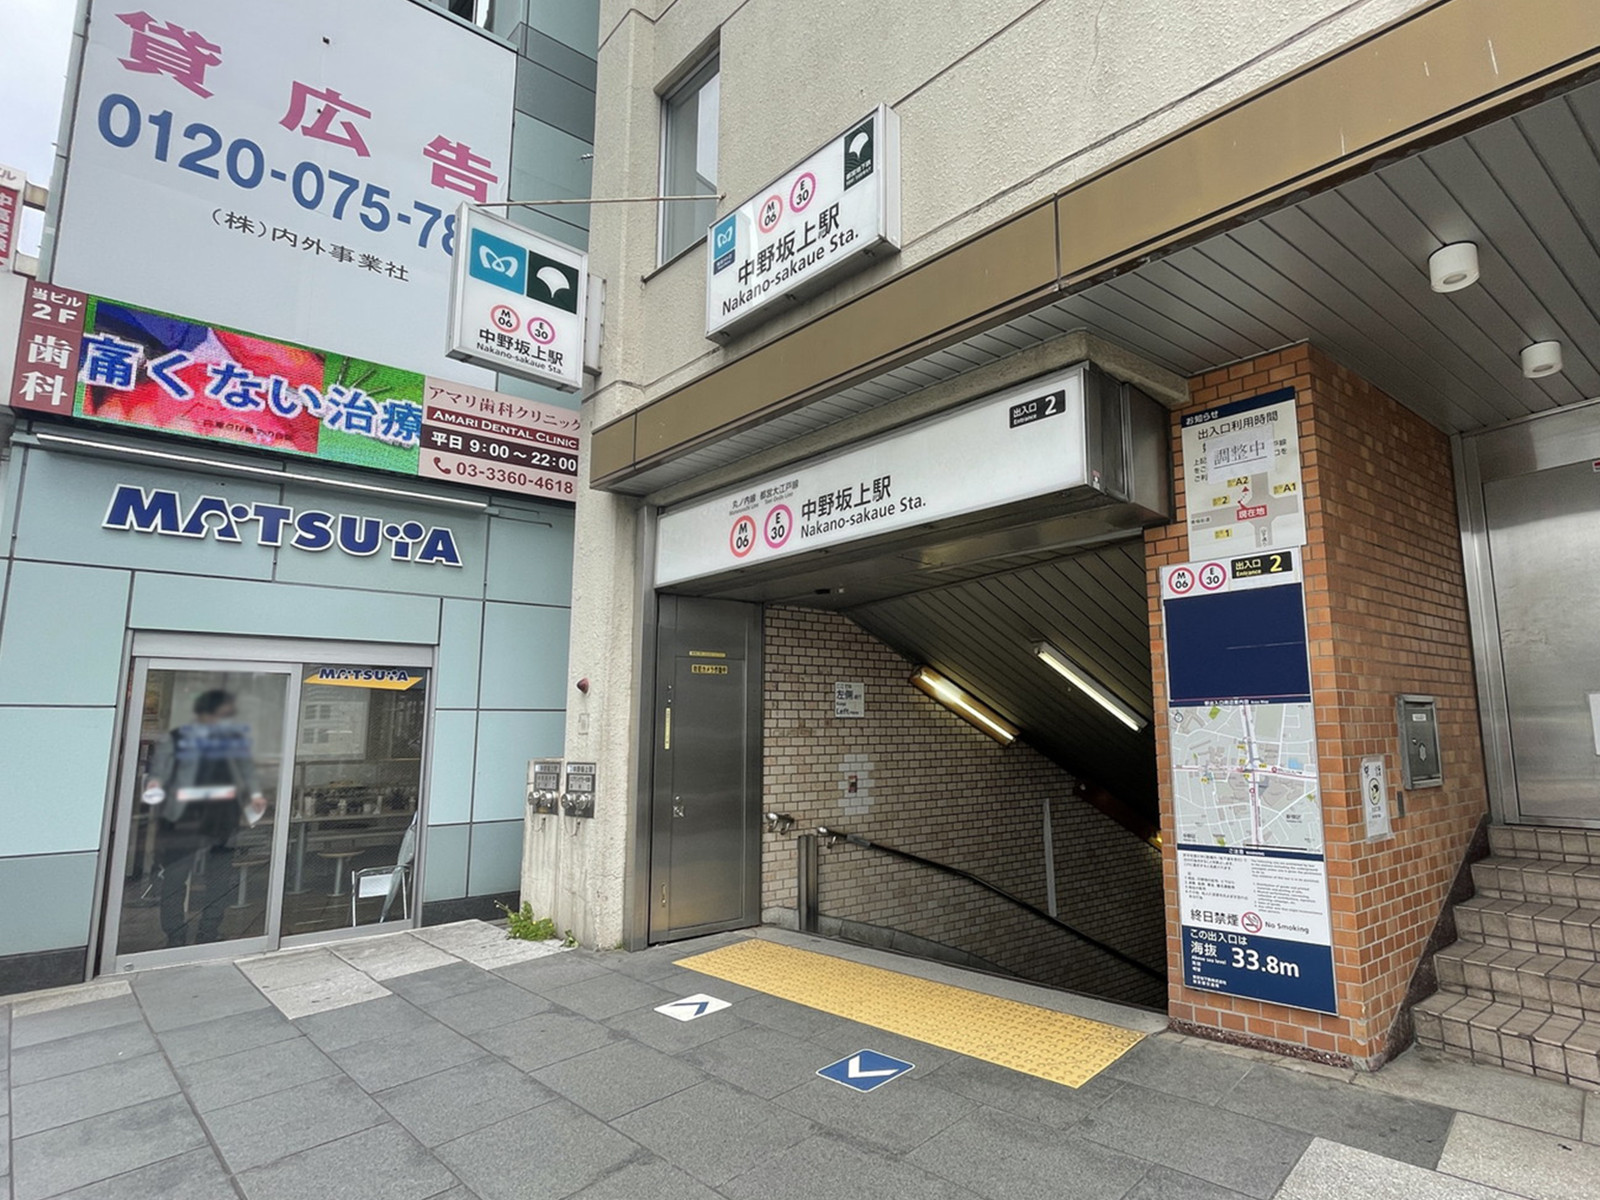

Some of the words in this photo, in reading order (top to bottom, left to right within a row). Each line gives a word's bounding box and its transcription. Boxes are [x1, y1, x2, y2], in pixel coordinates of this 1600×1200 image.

[766, 201, 775, 212] M
[796, 190, 809, 206] 30
[764, 214, 777, 226] 06
[738, 202, 840, 286] 中野坂上駅
[722, 246, 825, 316] Nakano-sakaue
[829, 228, 859, 253] Sta.
[32, 287, 82, 308] 当ビル
[32, 303, 78, 324] 2F
[498, 317, 513, 328] 06
[501, 309, 511, 319] M
[534, 329, 548, 340] 30
[479, 328, 564, 367] 中野坂上駅
[476, 342, 546, 370] Nakano-sakaue
[548, 363, 564, 375] Sta.
[19, 334, 74, 406] 歯科
[428, 386, 581, 432] アマリ歯科クリニック
[1013, 402, 1037, 418] 出入口
[1045, 395, 1057, 415] 2
[1186, 410, 1219, 425] お知らせ
[1198, 410, 1279, 440] 出入口利用時間
[433, 411, 478, 428] AMARI
[481, 419, 533, 441] DENTAL
[535, 432, 577, 449] CLINIC
[431, 431, 462, 450] 平日
[469, 439, 509, 458] 9:00
[531, 451, 577, 471] 22:00
[1213, 440, 1265, 466] 調整中
[456, 461, 574, 494] 03-3360-4618
[1235, 475, 1249, 487] A2
[1283, 482, 1296, 493] A1
[801, 475, 891, 521] 中野坂上駅
[1221, 496, 1228, 505] 2
[775, 512, 781, 524] E
[801, 503, 896, 539] Nakano-sakaue
[900, 495, 926, 512] Sta.
[738, 522, 748, 535] M
[770, 524, 785, 540] 30
[736, 535, 749, 549] 06
[1235, 559, 1261, 571] 出入口
[1269, 554, 1282, 573] 2
[1175, 580, 1188, 589] 06
[1177, 571, 1186, 579] M
[1206, 575, 1220, 585] 30
[1190, 908, 1239, 927] 終日禁煙
[1277, 922, 1310, 934] Smoking
[1190, 928, 1248, 945] この出入口は
[1190, 940, 1218, 957] 海抜
[1231, 947, 1300, 978] 33.8m
